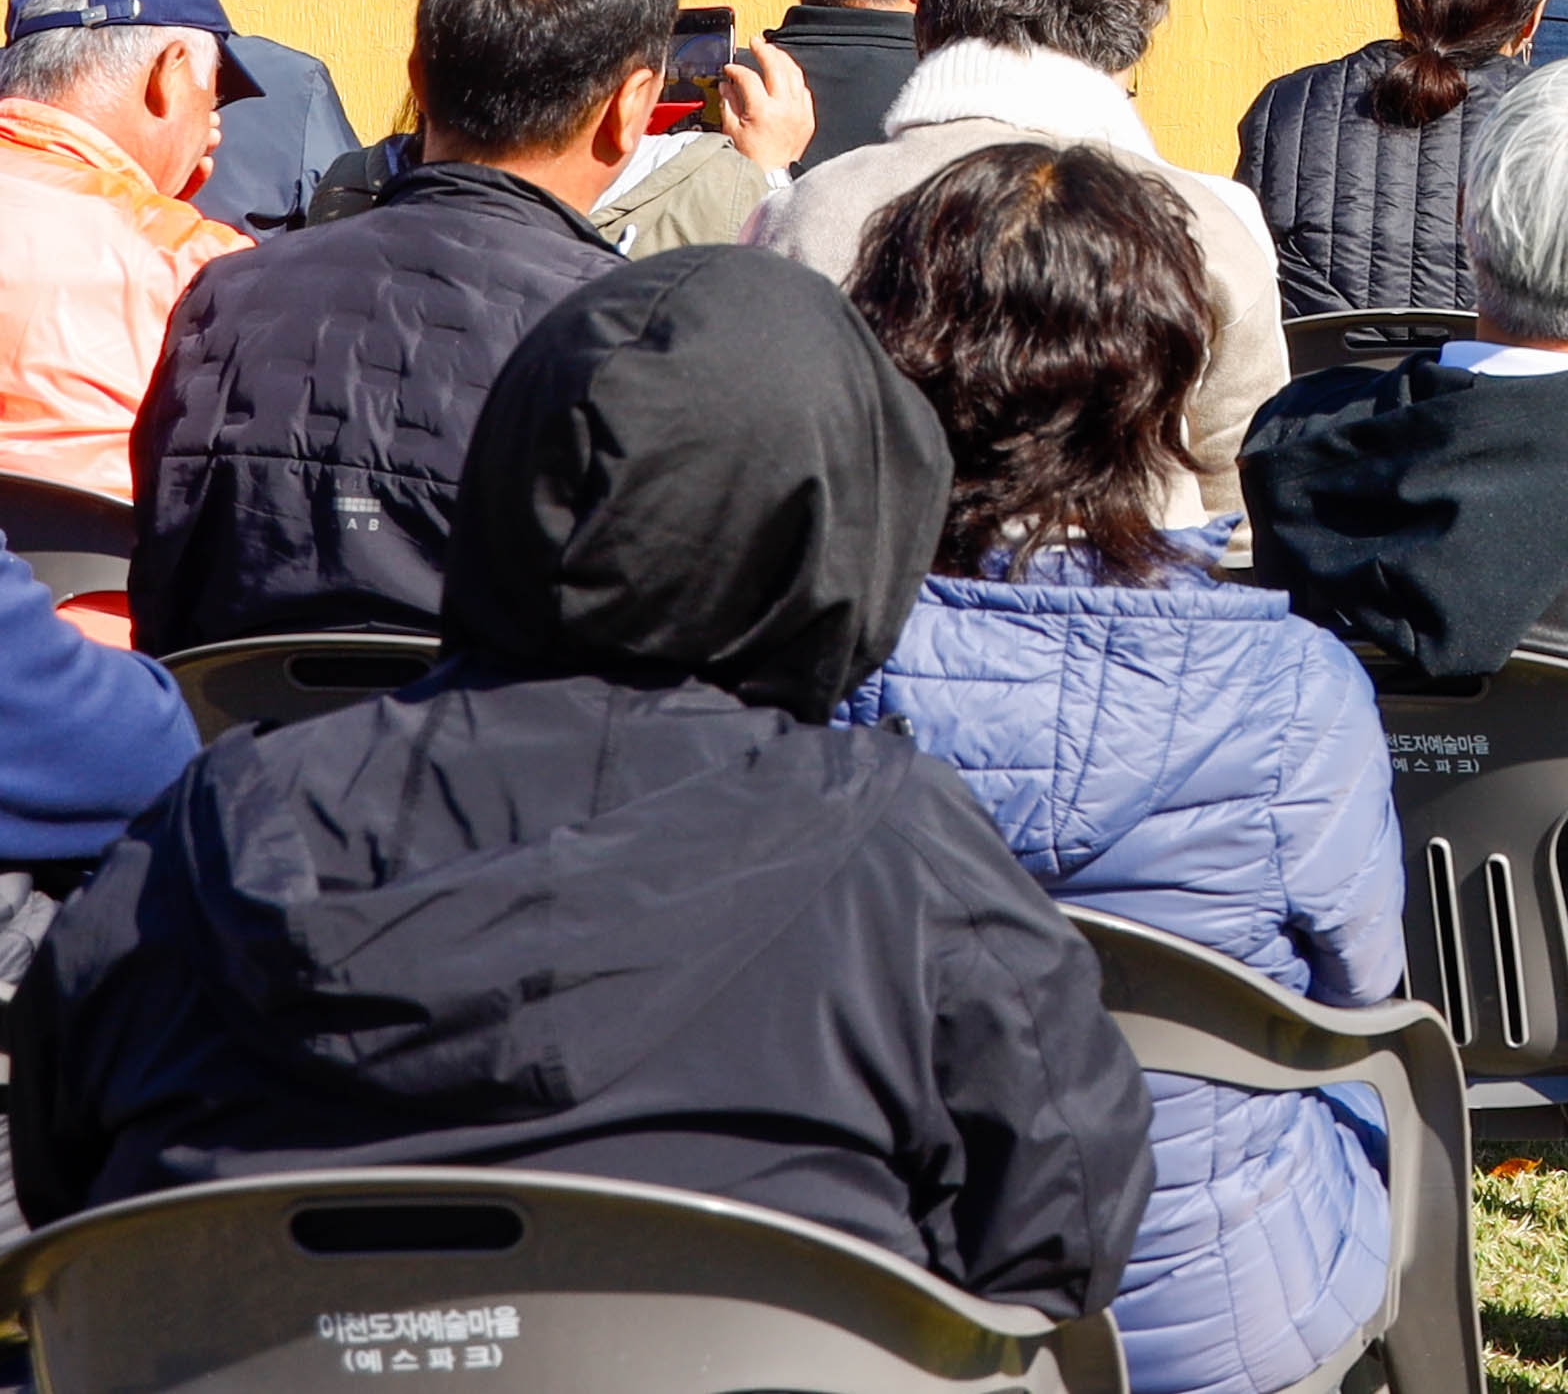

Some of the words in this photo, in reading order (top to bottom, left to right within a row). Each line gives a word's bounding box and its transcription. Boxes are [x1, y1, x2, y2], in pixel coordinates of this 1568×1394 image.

[345, 517, 380, 532] AB
[1385, 733, 1490, 755] 천도자예술마을
[317, 1305, 520, 1344] 이천도자예술마을
